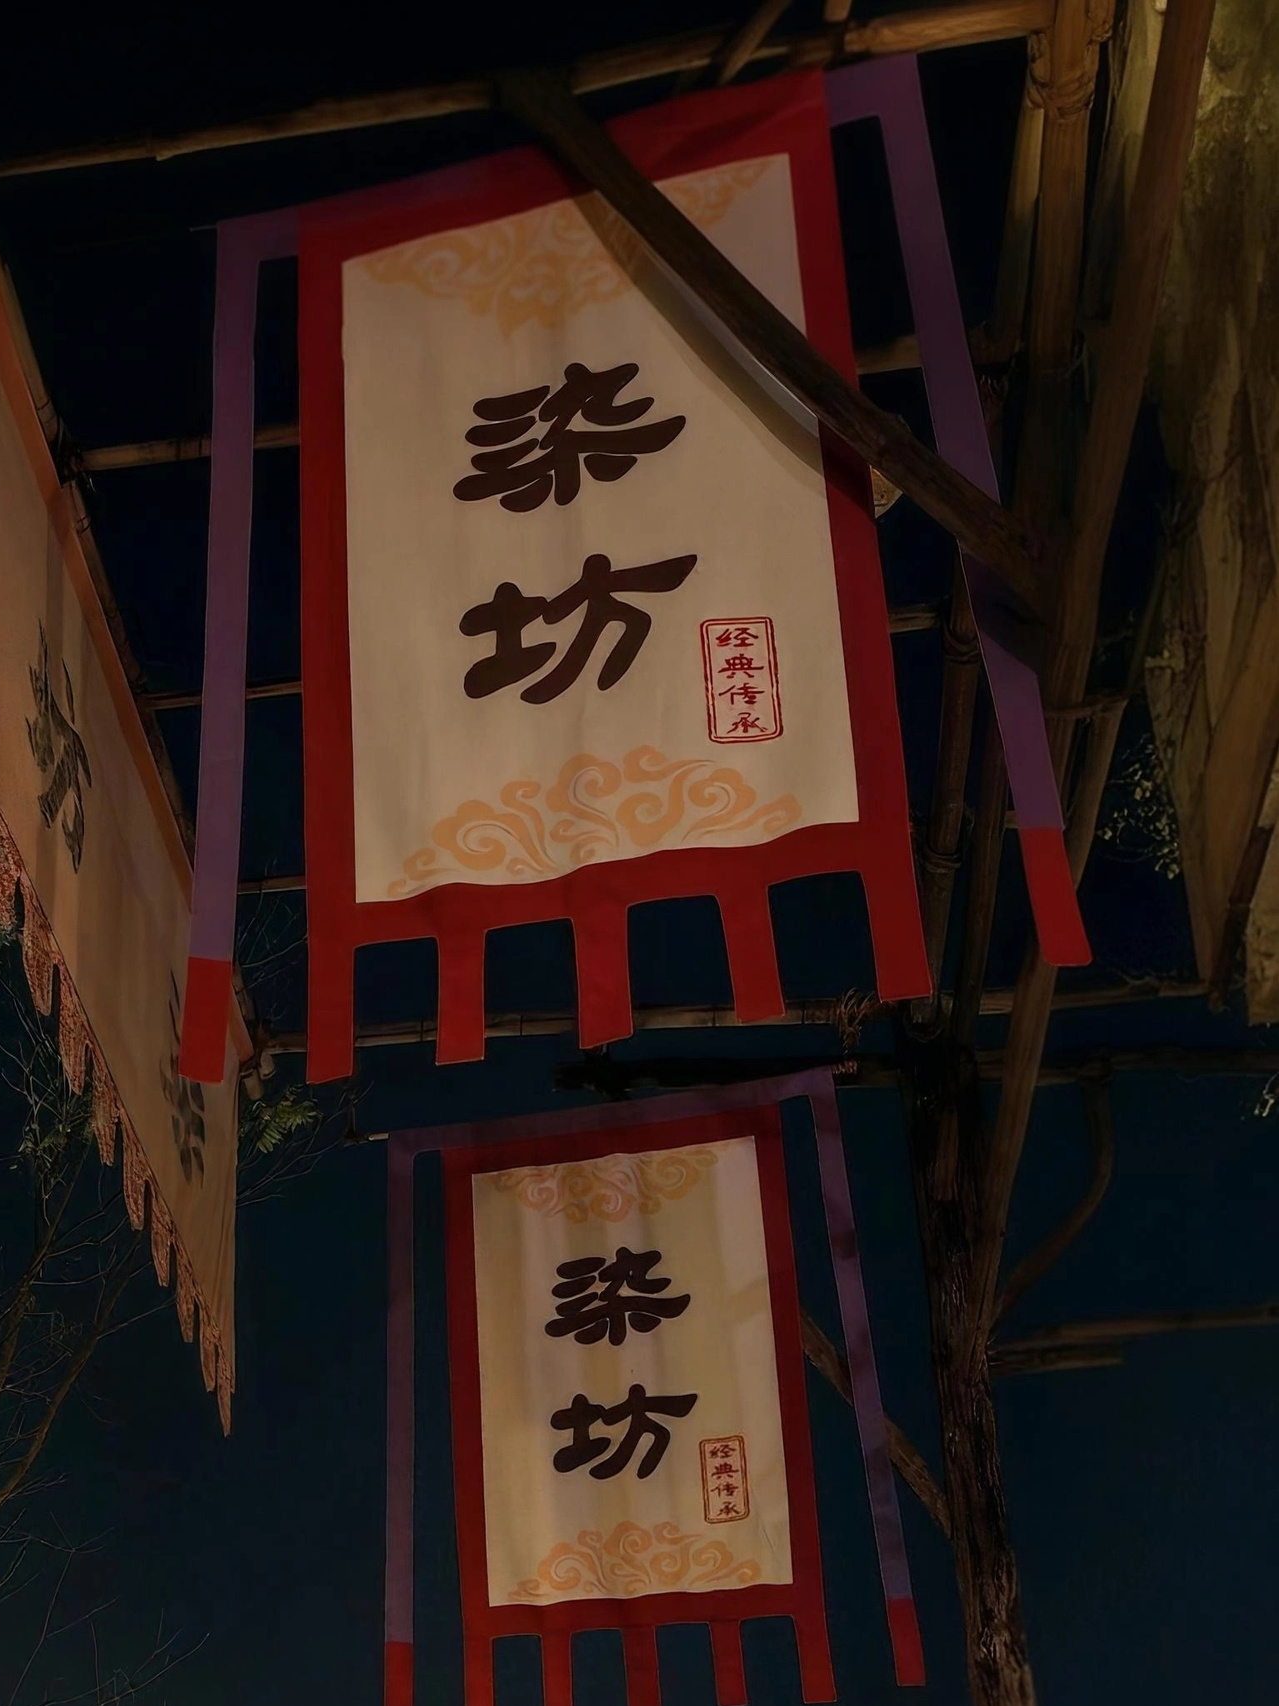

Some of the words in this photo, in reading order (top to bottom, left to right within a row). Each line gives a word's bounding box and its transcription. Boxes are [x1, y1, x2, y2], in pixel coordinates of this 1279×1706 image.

[452, 362, 698, 705] 染坊
[715, 627, 768, 734] 经典传承
[544, 1246, 698, 1480] 染坊
[709, 1443, 741, 1517] 经典传承
